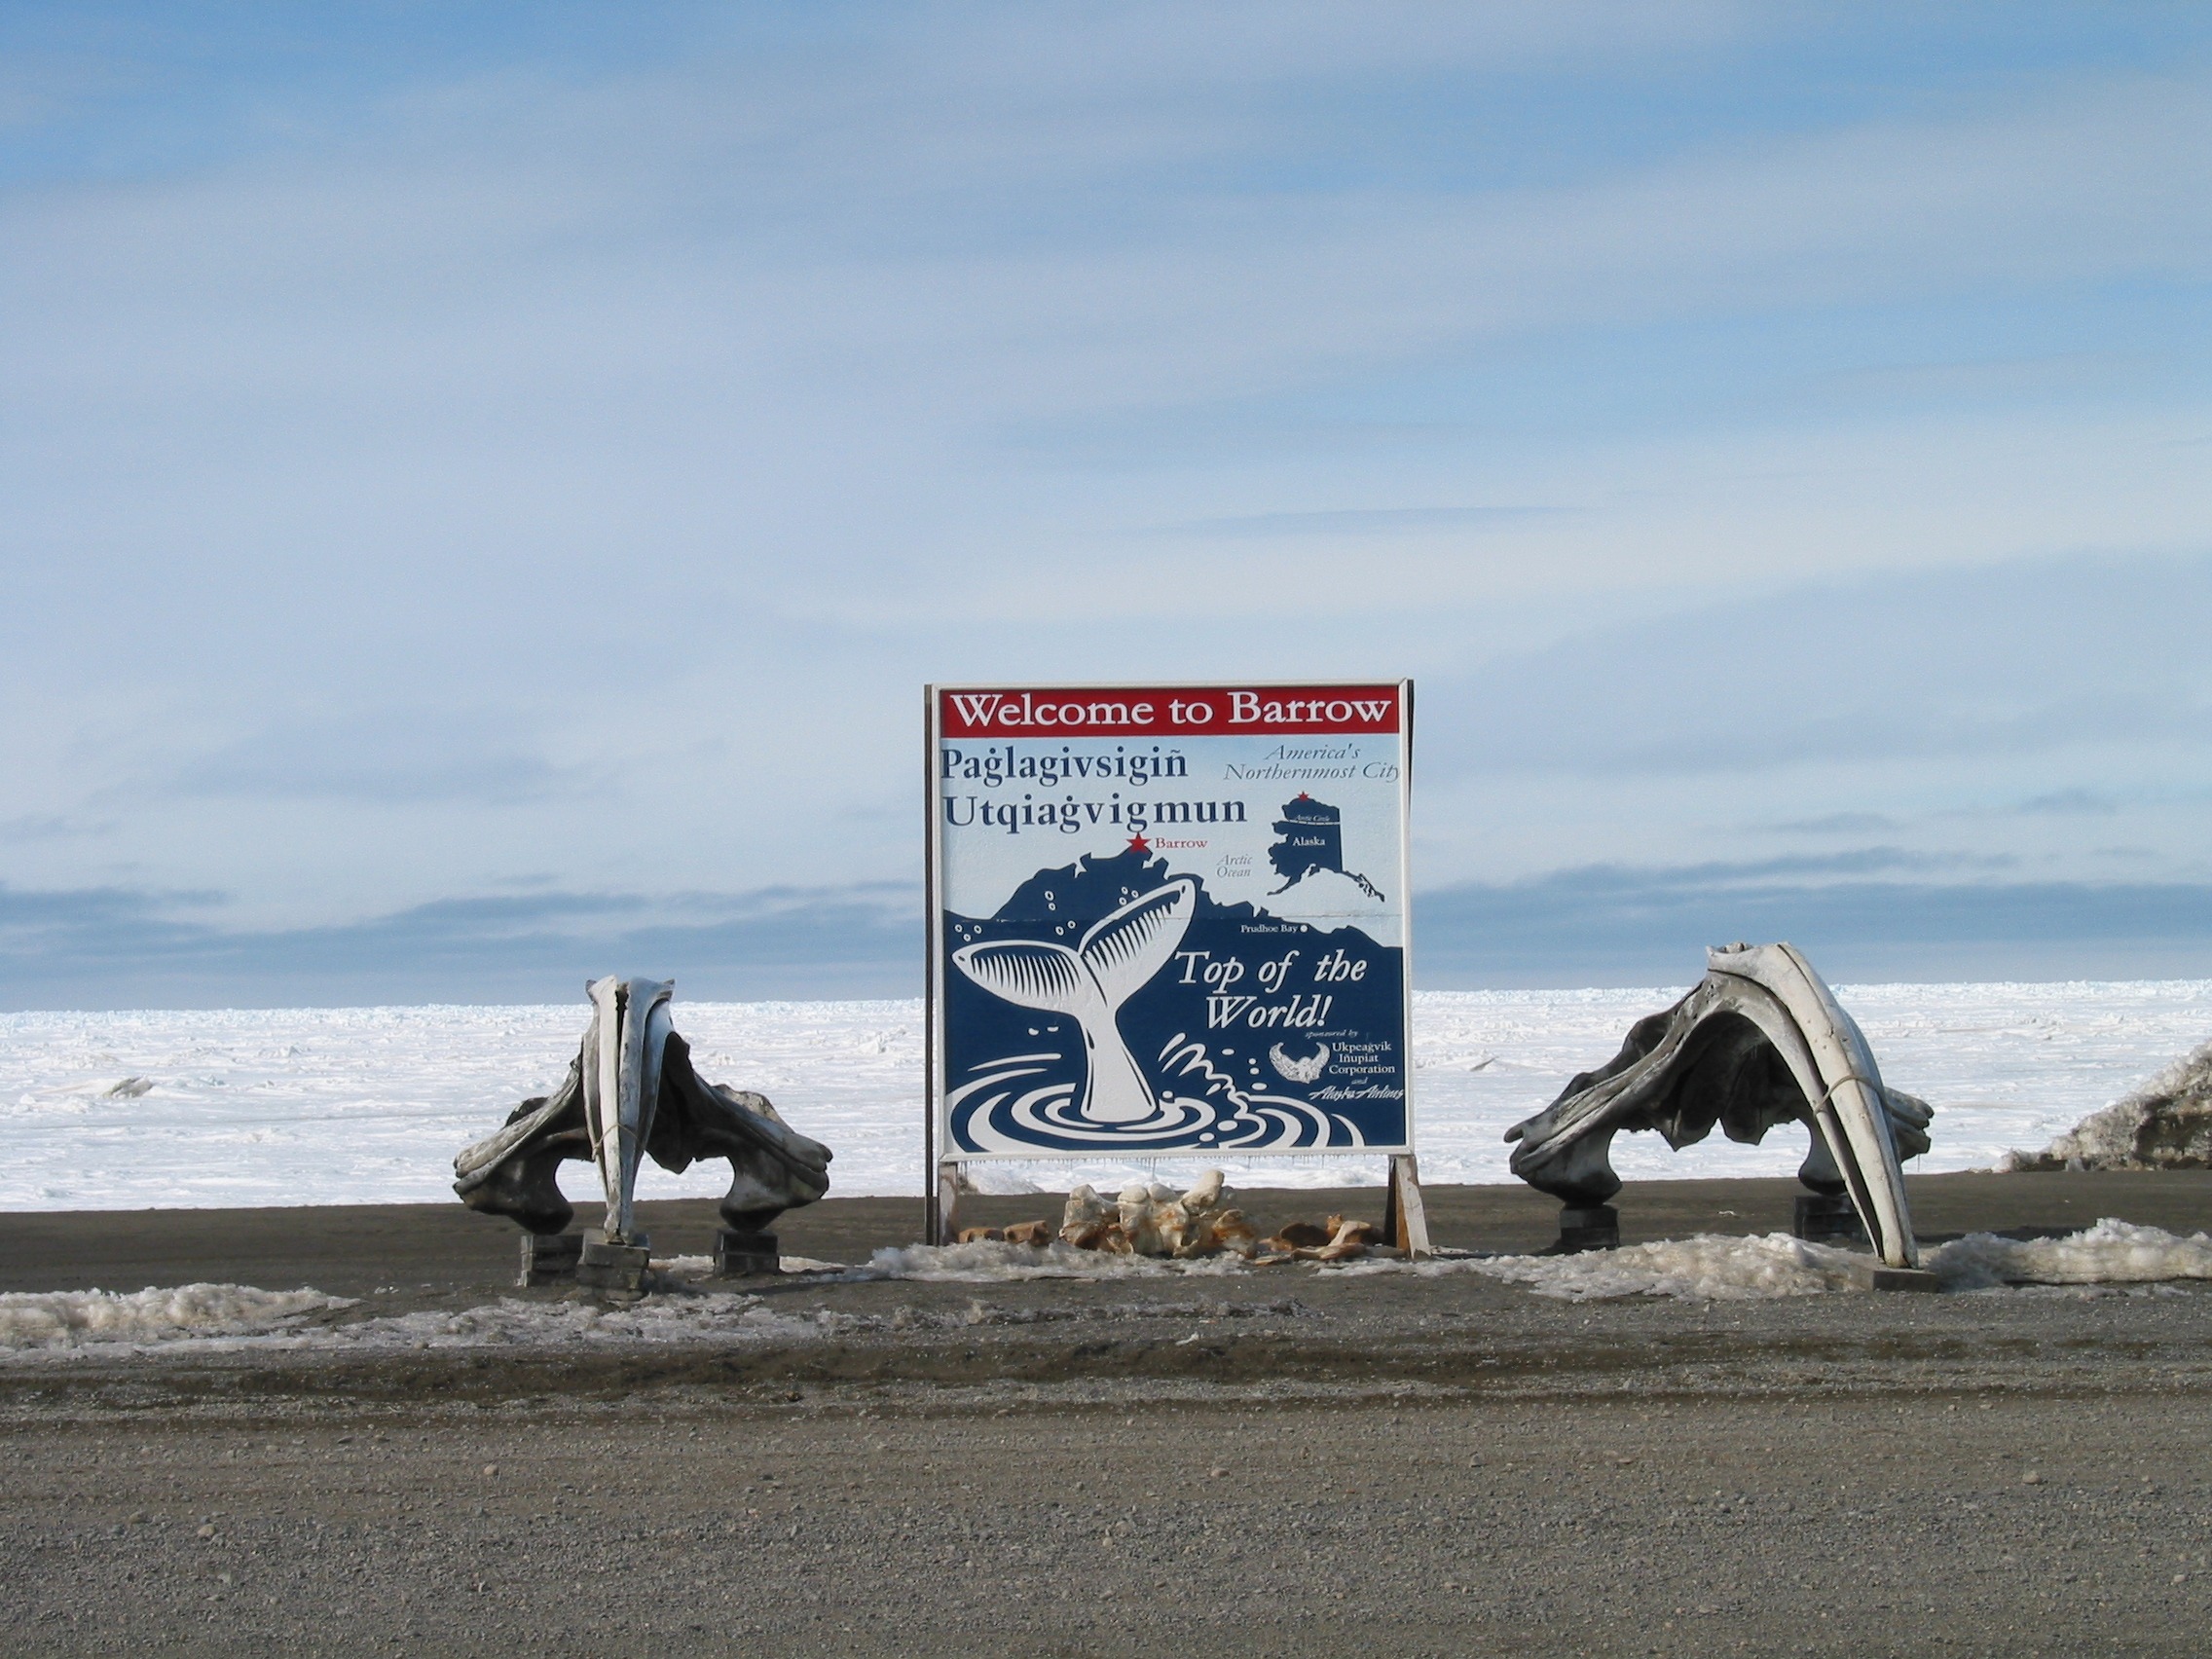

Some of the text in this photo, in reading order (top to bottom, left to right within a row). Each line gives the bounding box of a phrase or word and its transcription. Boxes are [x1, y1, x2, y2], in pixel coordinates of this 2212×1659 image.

[949, 691, 1391, 727] Welcome to Barrow
[1265, 743, 1361, 760] America's
[1224, 761, 1399, 783] Northernmost City
[1155, 837, 1208, 849] Barrow
[1293, 836, 1325, 846] Alaska
[1217, 854, 1253, 866] Arctic
[1217, 866, 1252, 877] Ocean
[1240, 925, 1299, 935] Prudhoe Bay
[1174, 948, 1368, 994] Top of the
[1205, 994, 1333, 1029] World!
[1329, 1064, 1395, 1076] Corporation
